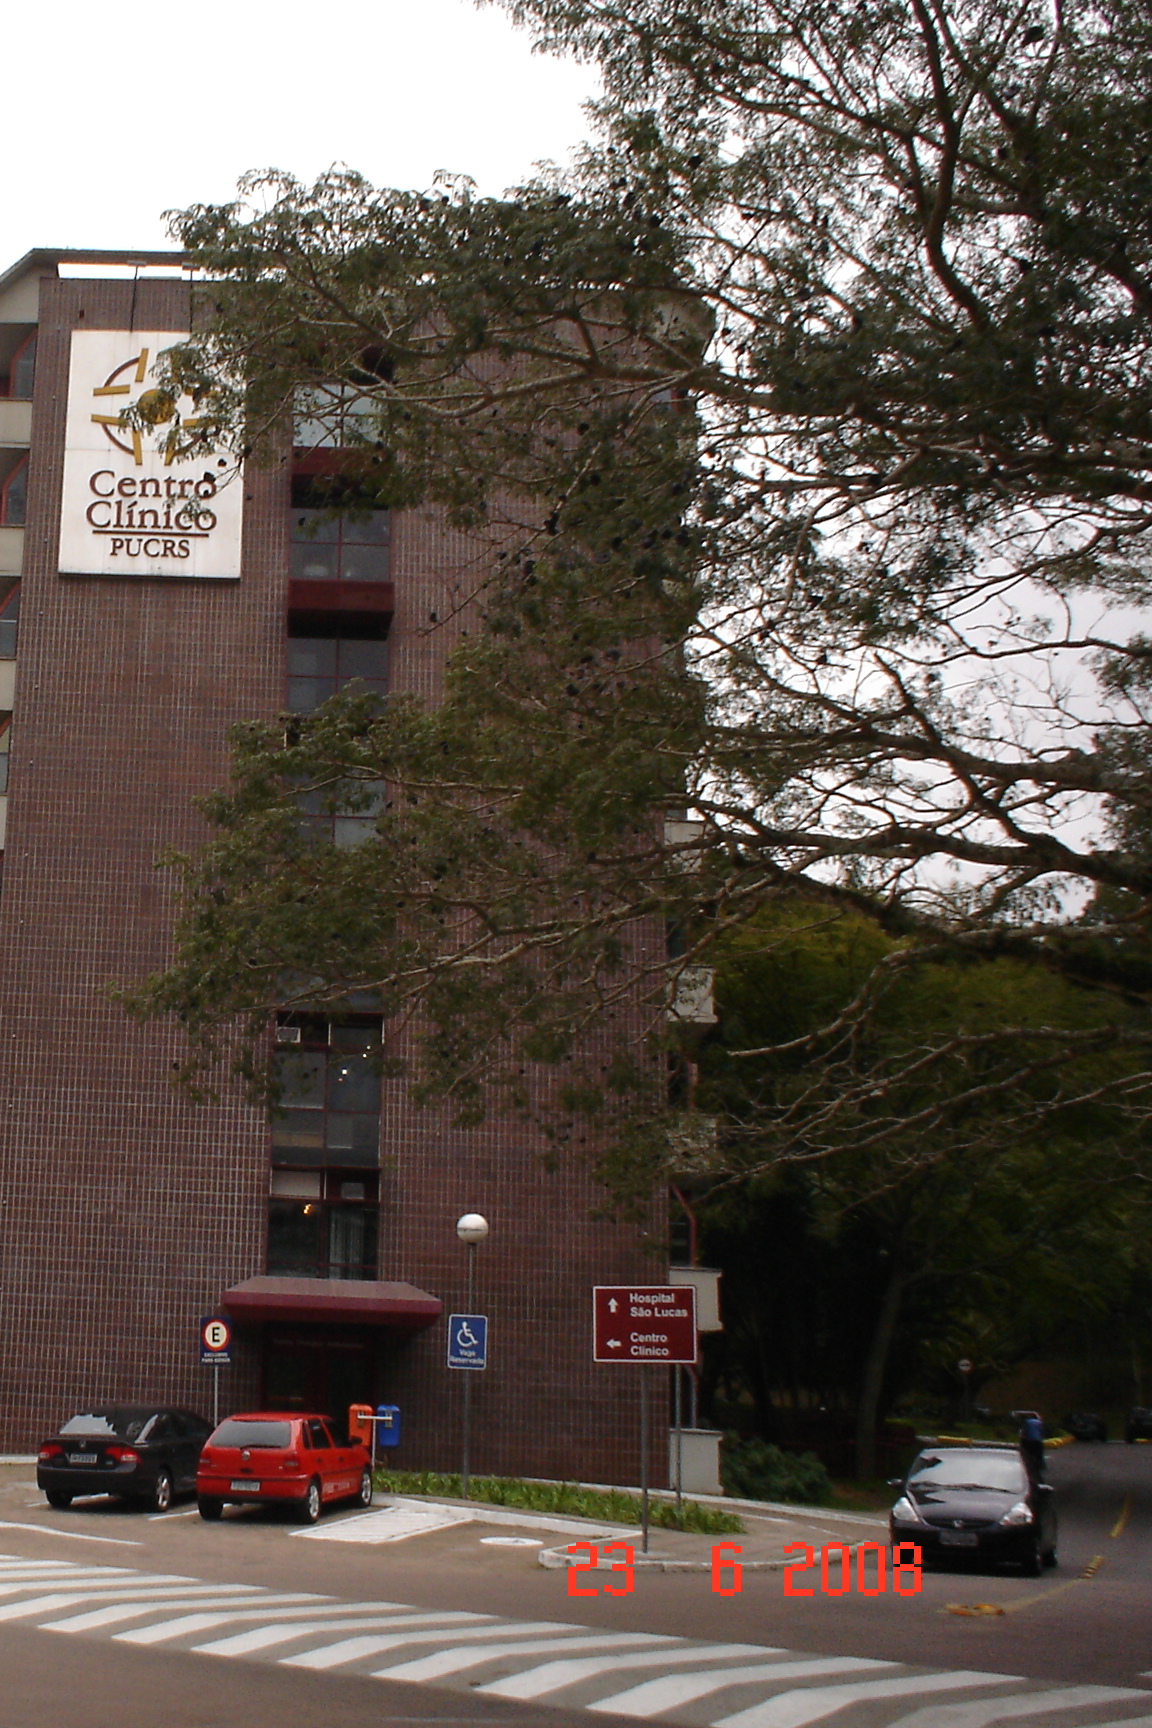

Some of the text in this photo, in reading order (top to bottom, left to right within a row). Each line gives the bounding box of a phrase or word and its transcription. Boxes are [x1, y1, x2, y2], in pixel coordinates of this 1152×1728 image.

[89, 470, 217, 500] Centro
[86, 500, 217, 531] Clínico
[110, 538, 190, 558] PUCRS
[629, 1293, 675, 1305] Hospital
[630, 1306, 687, 1317] São Lucas
[212, 1326, 220, 1342] E
[630, 1332, 668, 1342] Centro
